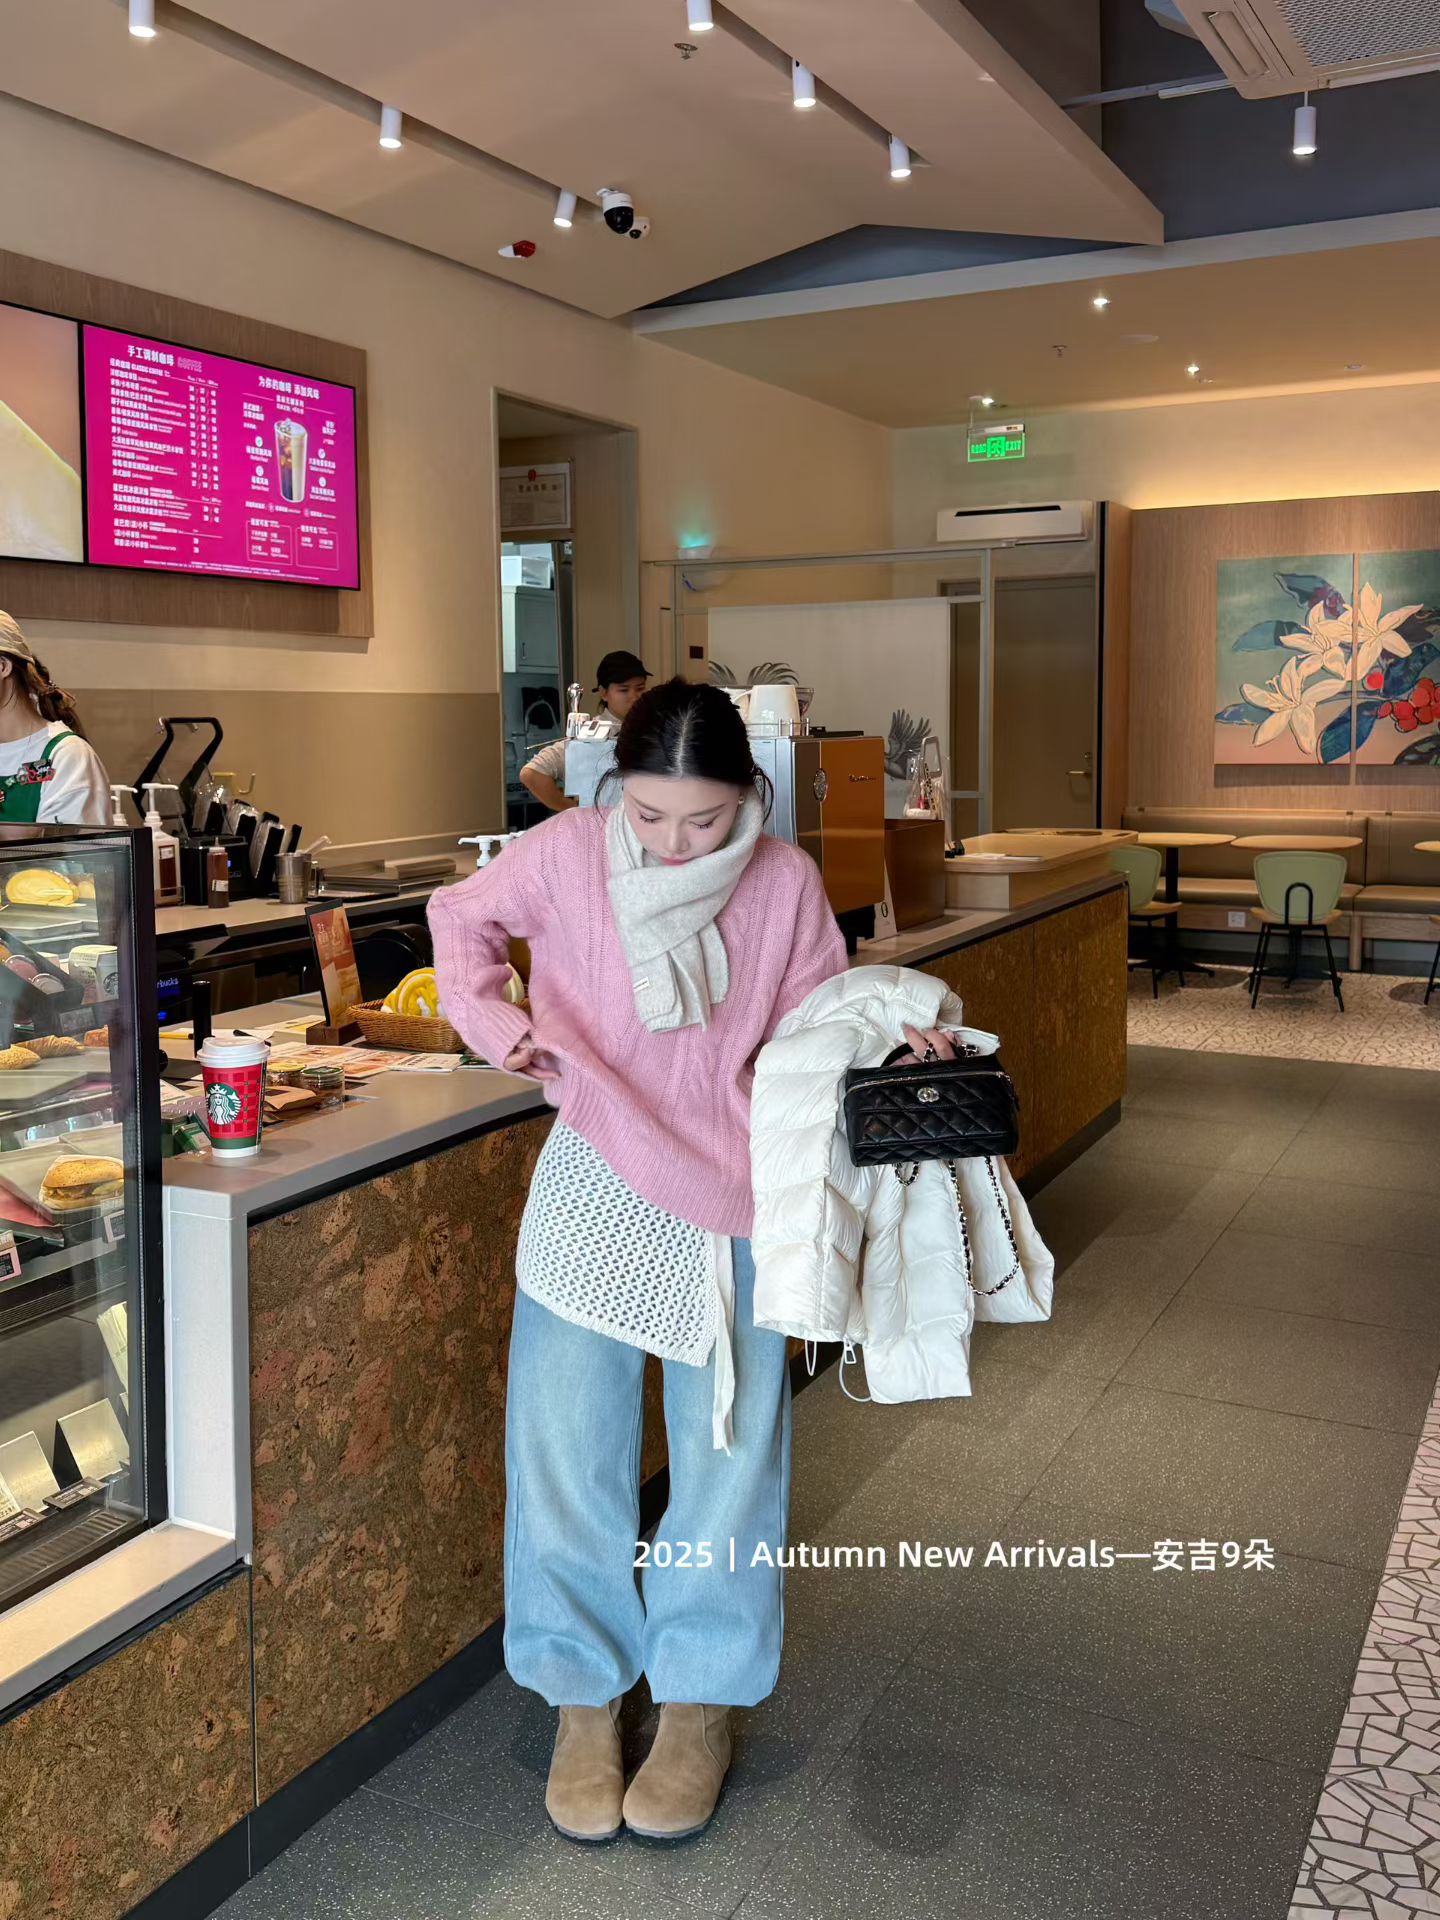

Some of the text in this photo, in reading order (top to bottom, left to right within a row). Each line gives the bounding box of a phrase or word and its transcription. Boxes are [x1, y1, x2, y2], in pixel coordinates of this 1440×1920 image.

[127, 345, 174, 366] 手工调制咖啡
[258, 375, 320, 399] 为你的咖啡 添加风味
